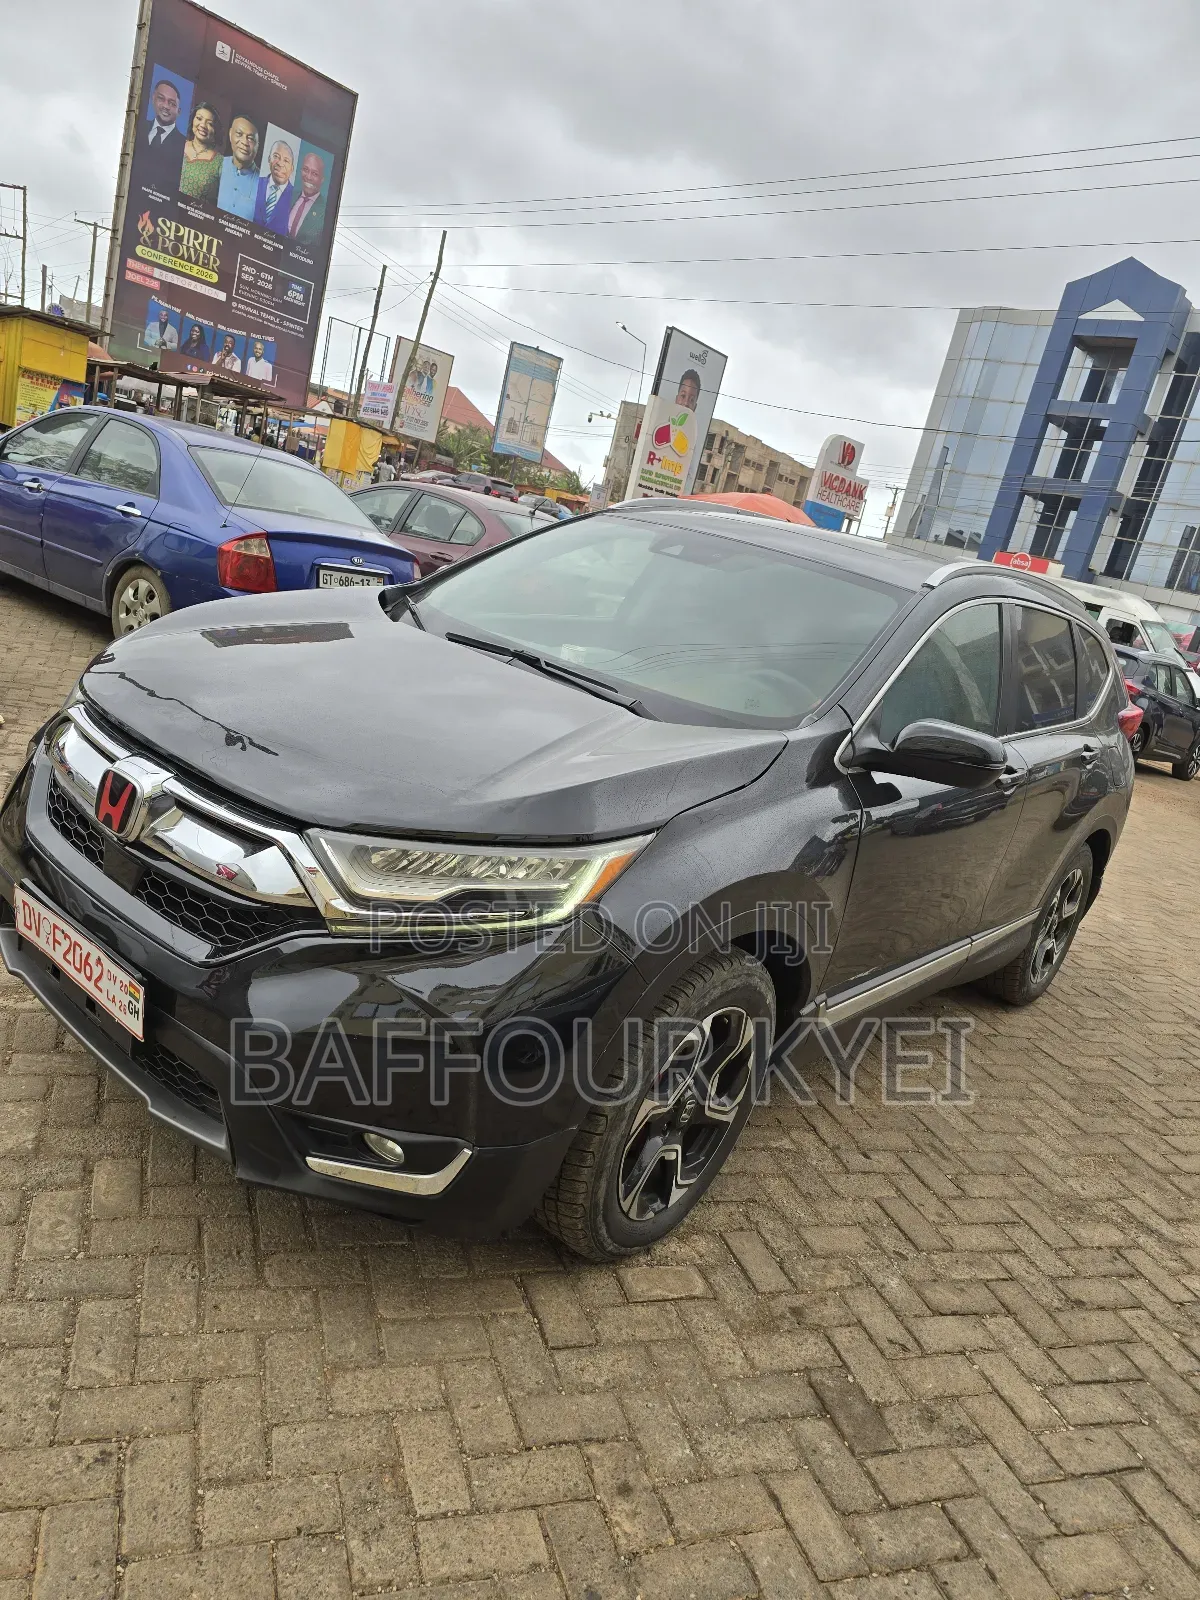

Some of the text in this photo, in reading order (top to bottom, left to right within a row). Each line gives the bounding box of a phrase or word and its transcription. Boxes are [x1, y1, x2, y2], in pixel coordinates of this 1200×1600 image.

[264, 70, 280, 82] CHAPEL
[156, 217, 222, 256] SPIRIT
[140, 230, 220, 272] & POWER
[141, 248, 214, 280] CONFERENCE 2026
[242, 264, 256, 275] 2ND
[260, 272, 274, 282] 6TH
[127, 272, 144, 282] JOEL
[159, 272, 220, 298] RESTORATION
[257, 280, 273, 290] 2026
[288, 290, 304, 302] 6PM
[238, 303, 260, 315] REVIVAL
[260, 312, 280, 324] TEMPLE
[283, 320, 304, 332] SPINTEX
[403, 384, 434, 402] athering
[821, 471, 868, 500] VICDANK
[817, 488, 860, 512] HEALTHCARE
[1013, 558, 1028, 566] absa
[323, 574, 333, 585] GT
[22, 899, 41, 938] DV
[52, 922, 104, 993] F2062
[107, 969, 129, 995] DV 20
[128, 1000, 140, 1021] GH
